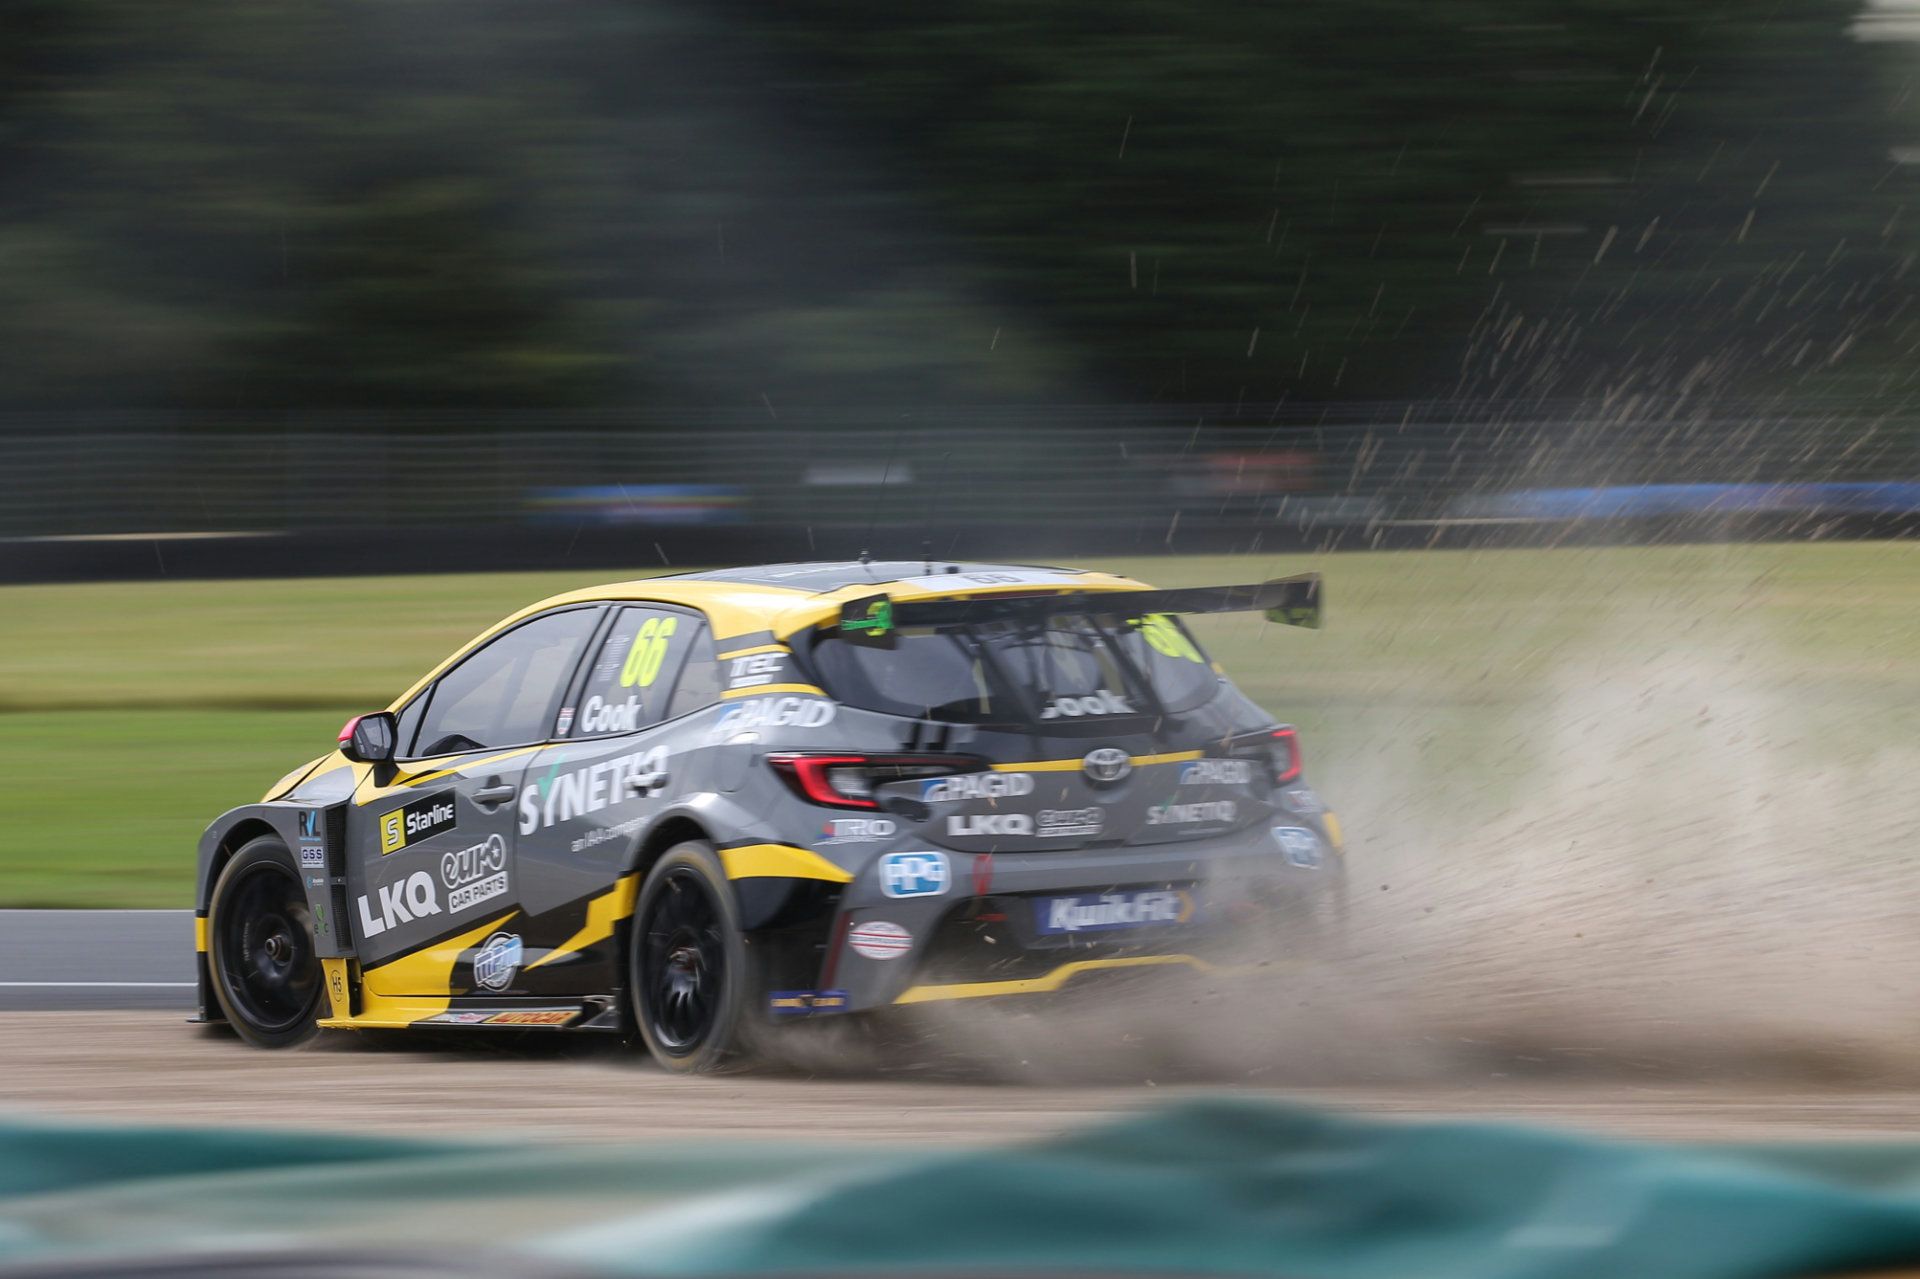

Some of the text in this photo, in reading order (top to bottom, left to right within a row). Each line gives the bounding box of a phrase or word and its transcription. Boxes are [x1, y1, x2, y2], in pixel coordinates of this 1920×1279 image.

[620, 616, 677, 687] 66
[581, 695, 643, 732] Cook
[944, 773, 1035, 799] PAGID
[406, 804, 454, 834] Starline
[947, 814, 1034, 836] LKQ
[302, 849, 323, 860] GSS
[441, 834, 506, 889] euro
[358, 871, 442, 938] LKQ
[451, 876, 505, 909] CAR PARTS
